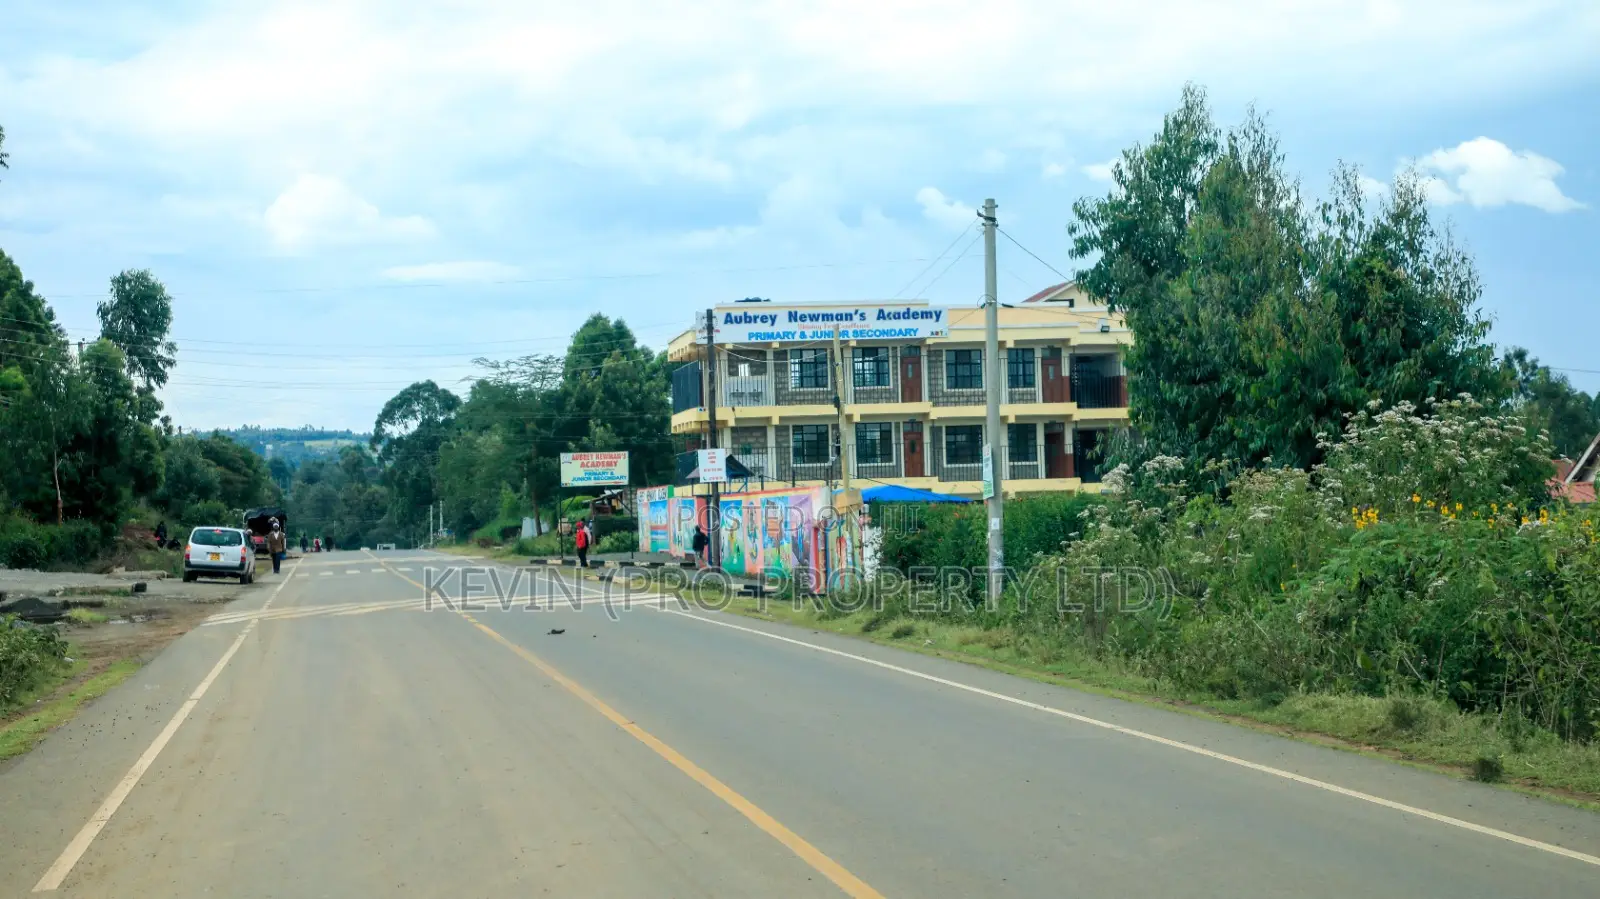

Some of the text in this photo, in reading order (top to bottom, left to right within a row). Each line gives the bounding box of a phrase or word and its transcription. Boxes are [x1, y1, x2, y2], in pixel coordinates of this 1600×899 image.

[724, 307, 942, 326] Aubrey Newman's Academy
[748, 330, 797, 340] PRIMARY
[799, 330, 808, 339] &
[852, 328, 919, 338] SECONDARY
[580, 460, 618, 468] ACADEMY
